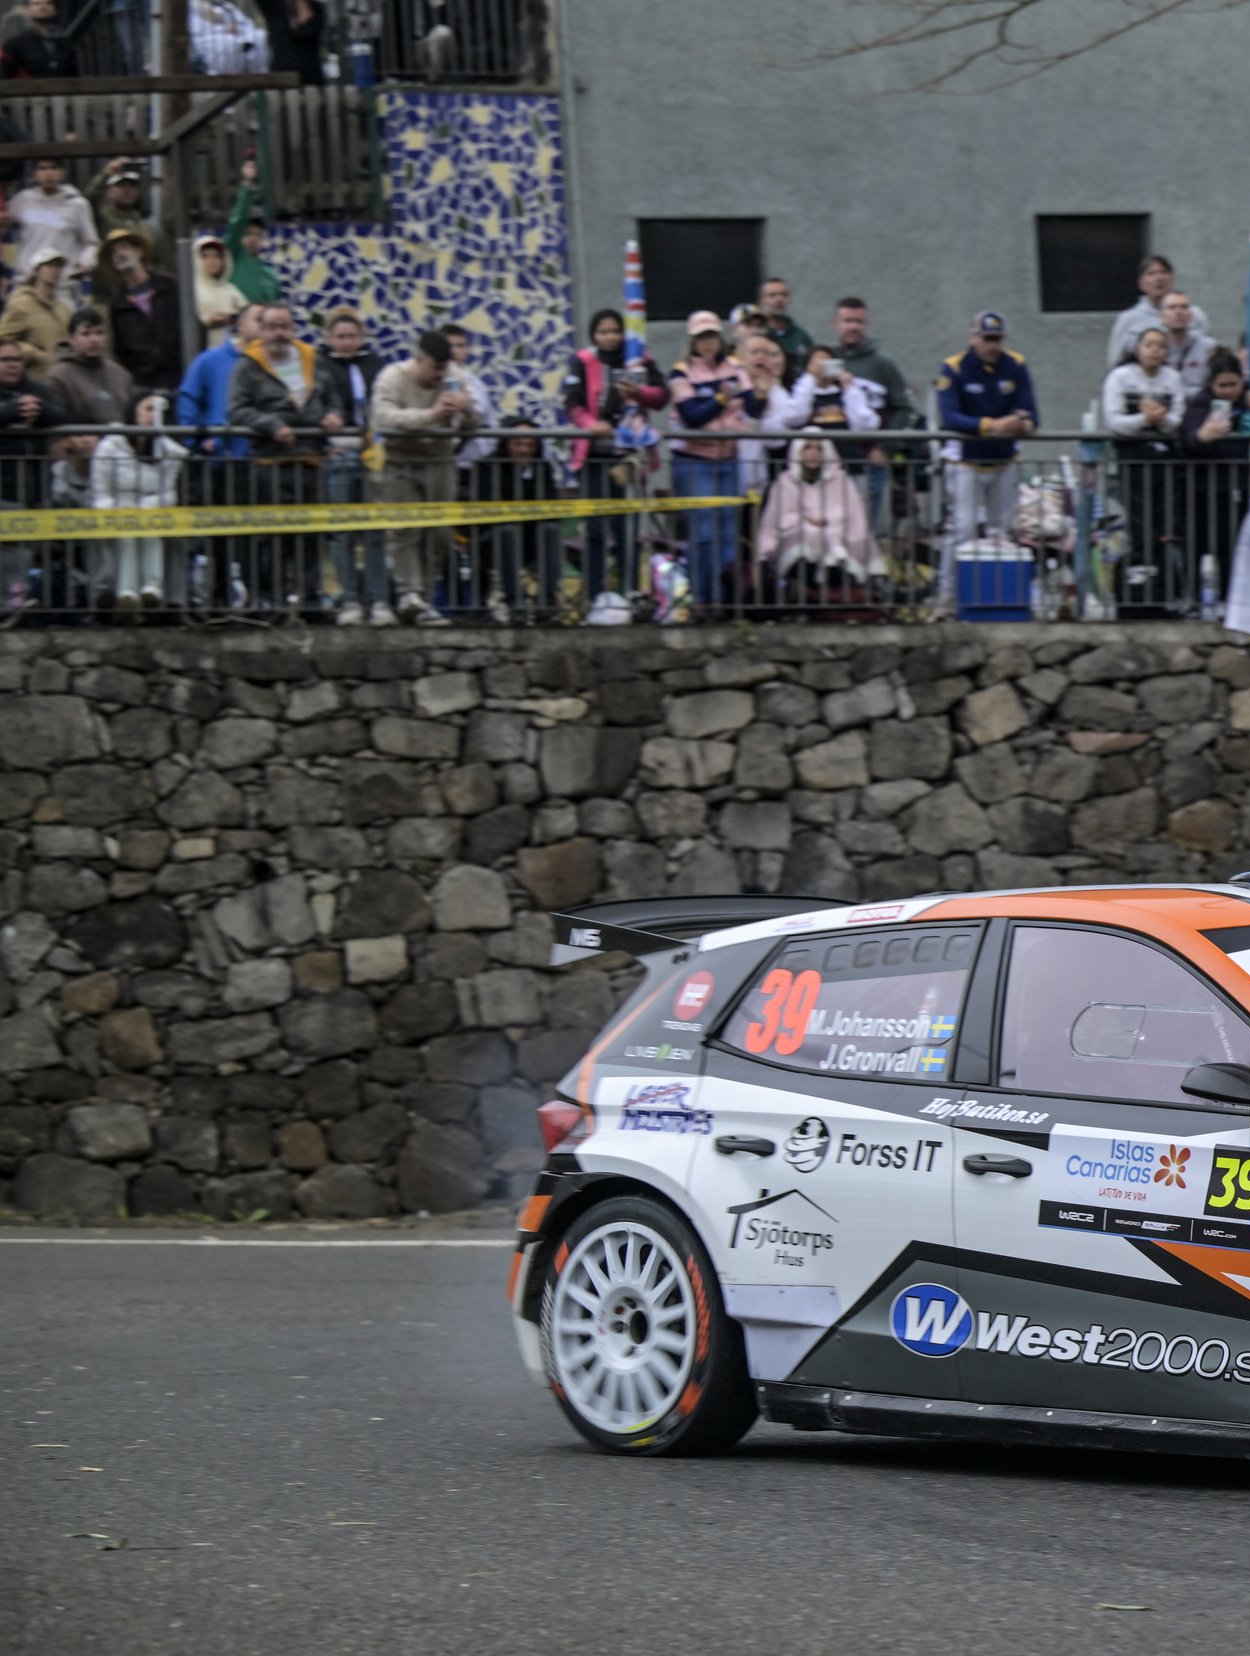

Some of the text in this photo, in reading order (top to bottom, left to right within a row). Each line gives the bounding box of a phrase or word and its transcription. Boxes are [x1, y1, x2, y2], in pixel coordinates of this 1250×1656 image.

[744, 968, 822, 1056] 39
[820, 1043, 922, 1073] J.Gronvall
[834, 1132, 944, 1173] Forss IT
[1109, 1138, 1155, 1164] Islas
[1066, 1154, 1152, 1184] Canarias
[743, 1217, 835, 1257] Sjötorps
[773, 1249, 806, 1267] Hus
[904, 1294, 970, 1346] W
